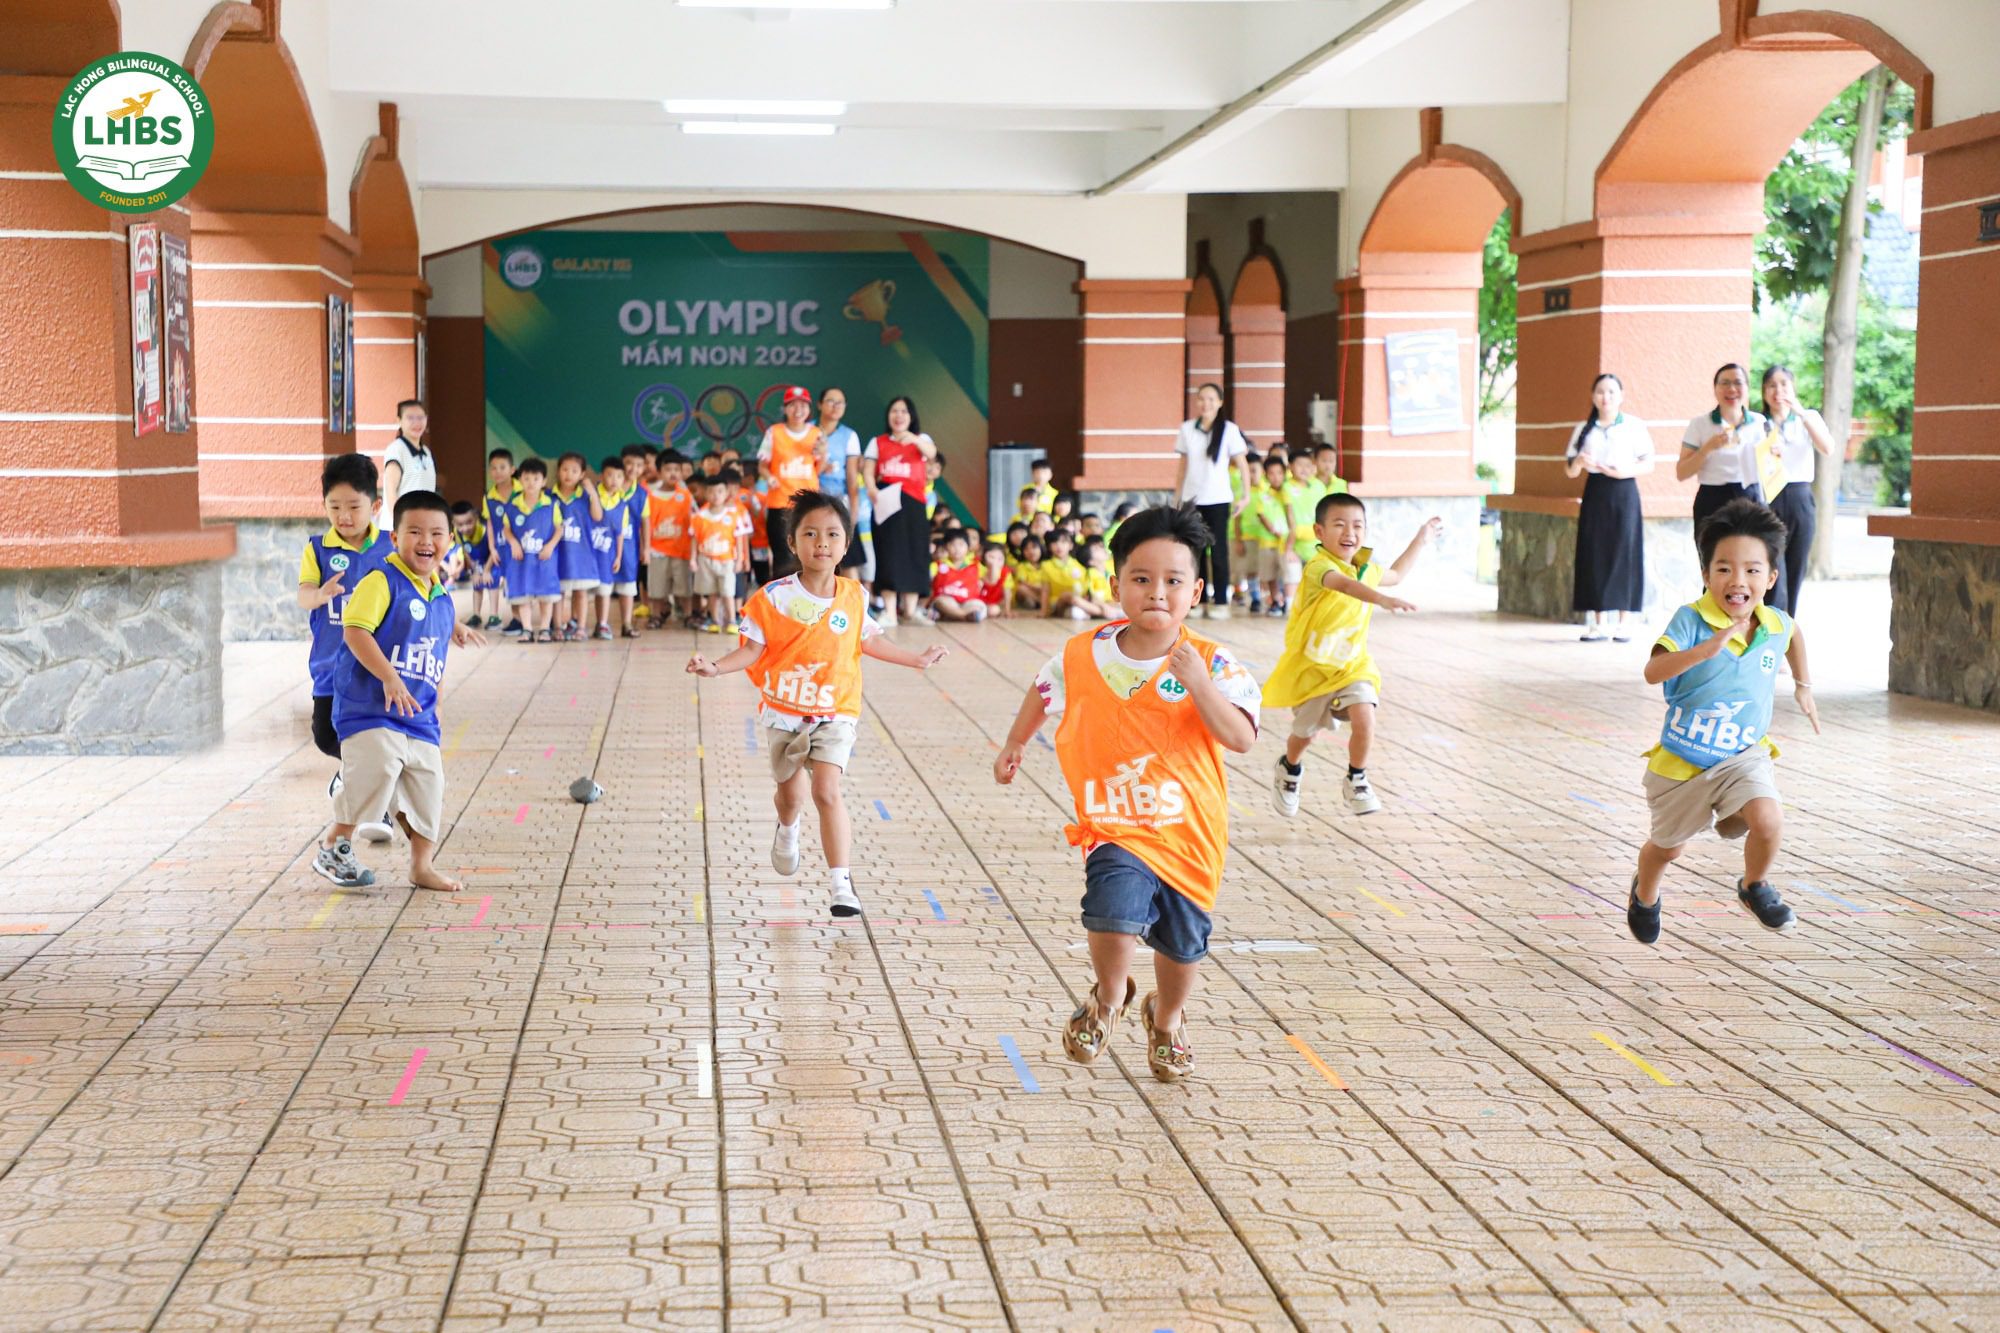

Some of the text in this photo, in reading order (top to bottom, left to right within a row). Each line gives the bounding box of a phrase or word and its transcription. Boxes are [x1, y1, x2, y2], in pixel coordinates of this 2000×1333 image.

[618, 300, 820, 335] OLYMPIC
[690, 346, 747, 366] NON
[755, 346, 818, 366] 2025
[331, 557, 348, 569] 05
[831, 615, 847, 629] 29
[390, 644, 444, 684] LHBS
[1761, 655, 1774, 669] 55
[762, 670, 836, 708] LHBS
[1159, 677, 1186, 695] 48
[1670, 705, 1758, 751] LHBS
[1085, 779, 1184, 818] LHBS
